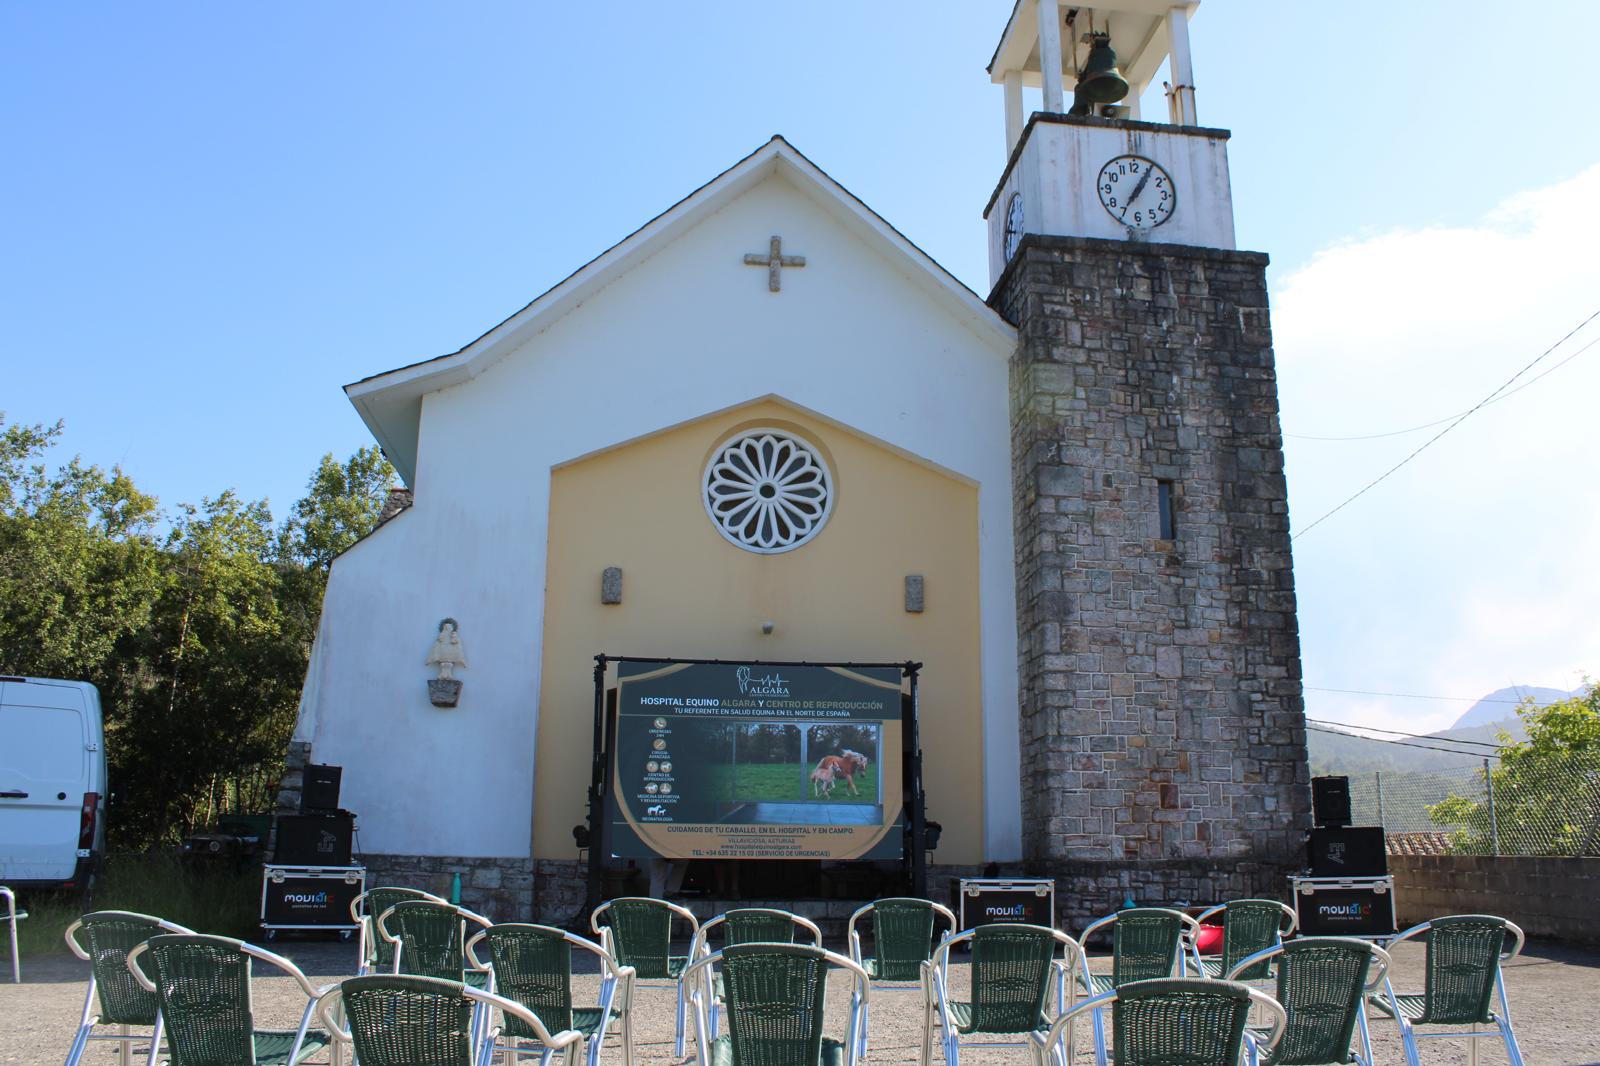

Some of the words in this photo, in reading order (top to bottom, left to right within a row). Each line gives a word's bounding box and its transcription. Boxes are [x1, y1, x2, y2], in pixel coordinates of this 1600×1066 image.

[1119, 165, 1125, 175] 11
[1129, 162, 1139, 173] 12
[1108, 172, 1118, 182] 10
[1155, 177, 1162, 188] 2
[1104, 184, 1112, 194] 9
[1160, 191, 1167, 200] 3
[1109, 197, 1116, 207] 8
[1158, 202, 1164, 212] 4
[1120, 206, 1127, 217] 7
[1149, 209, 1156, 219] 5
[1134, 212, 1141, 222] 6
[640, 697, 684, 706] HOSPITAL
[816, 700, 883, 709] REPRODUCCIÓN
